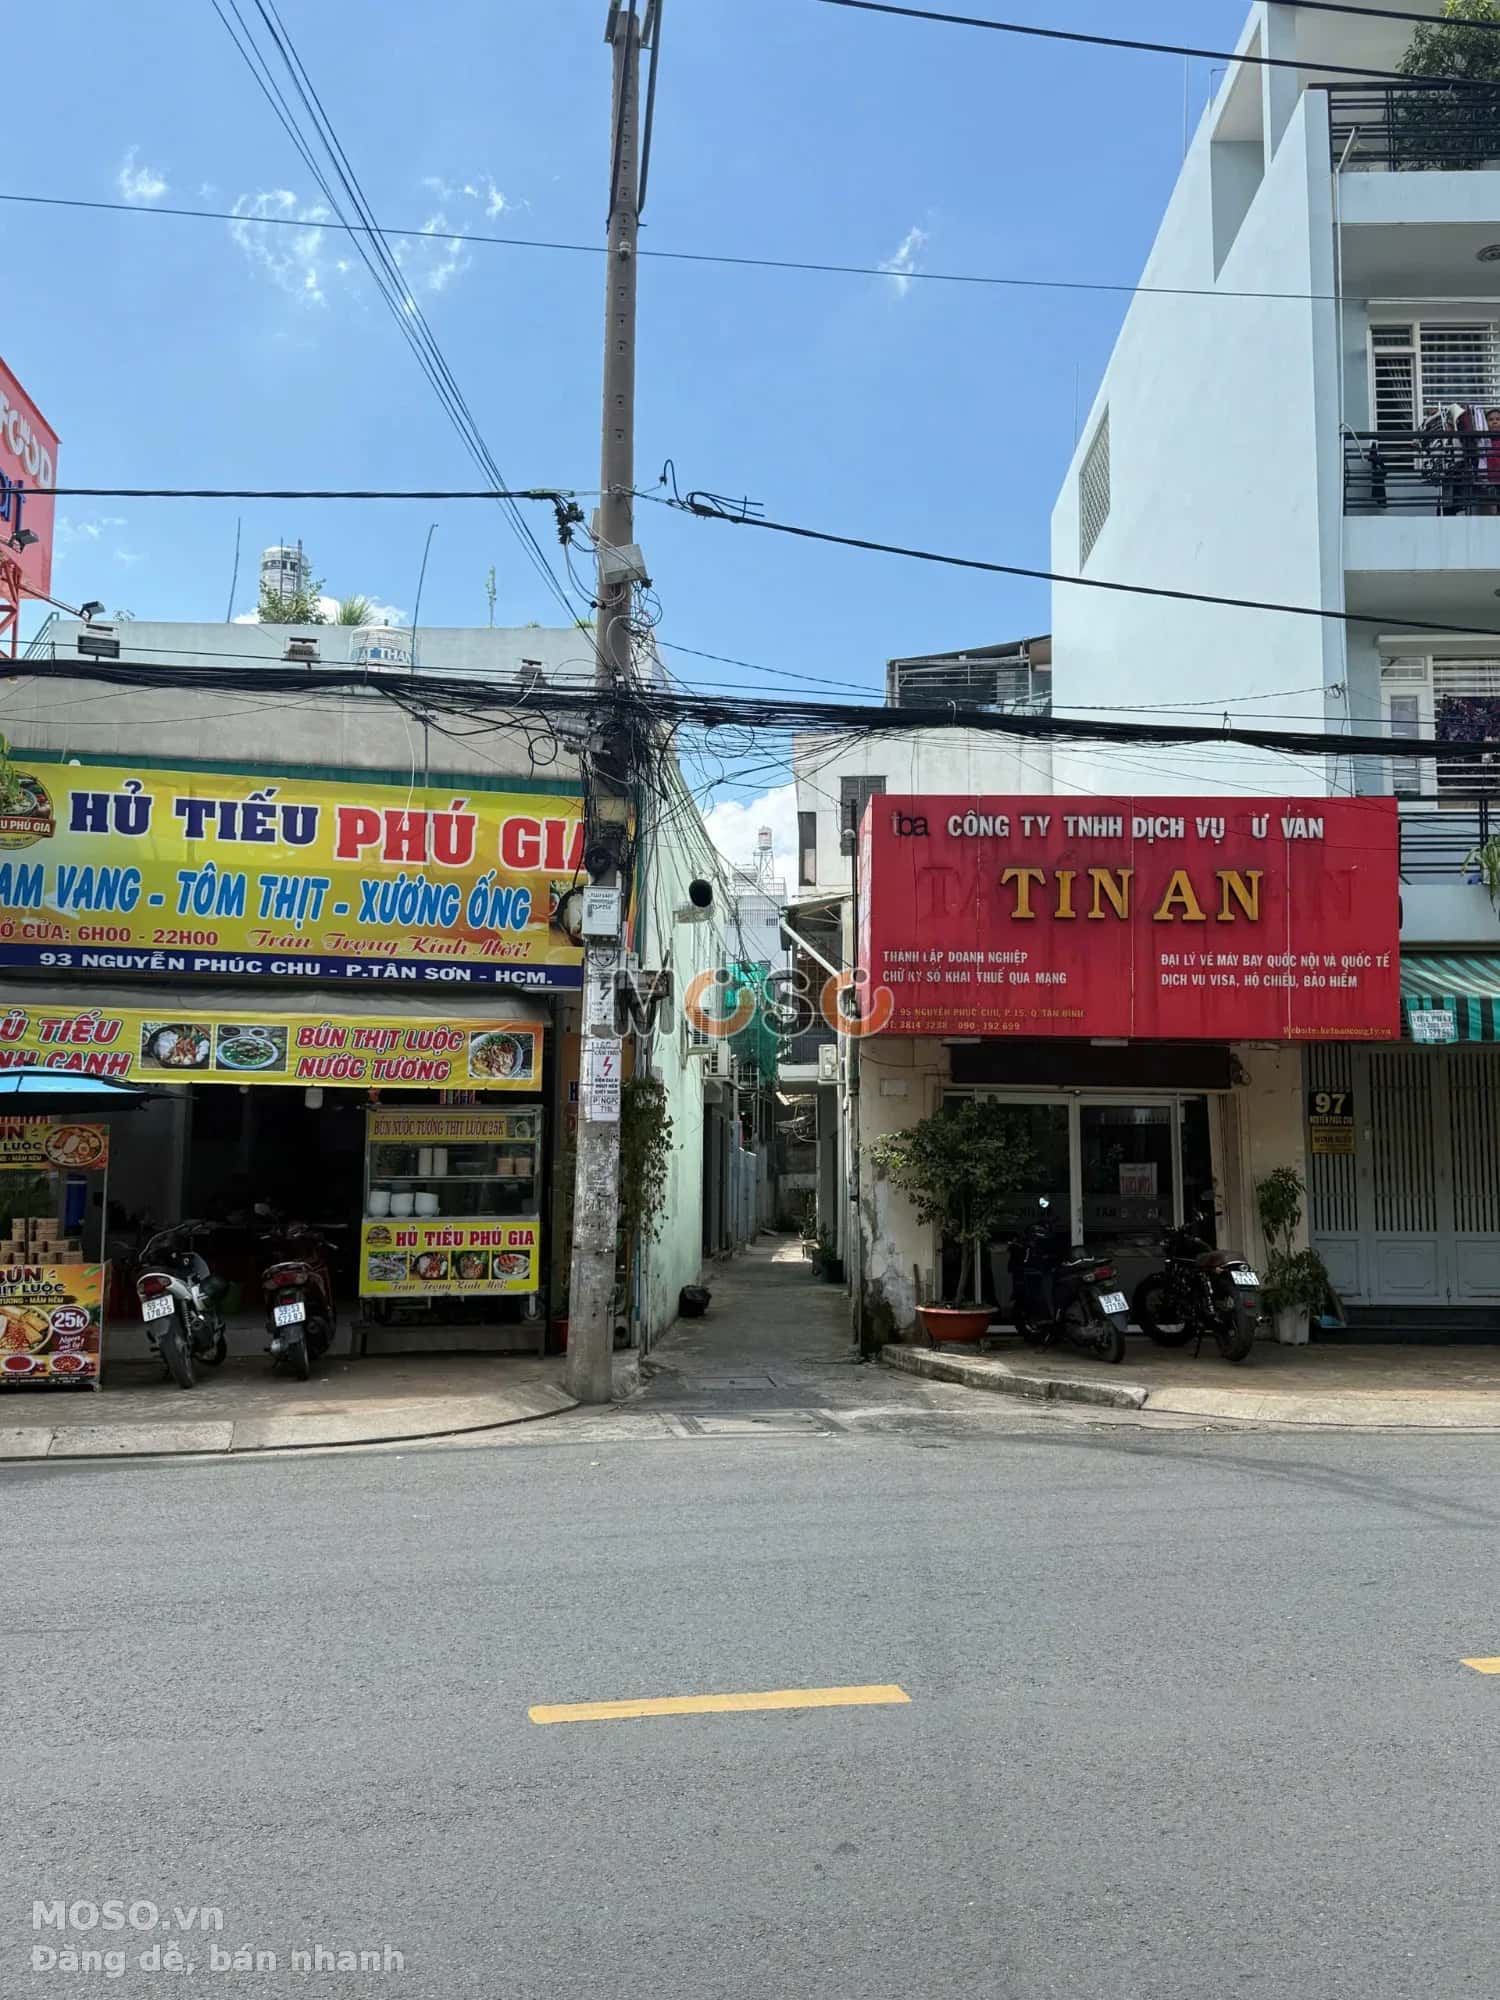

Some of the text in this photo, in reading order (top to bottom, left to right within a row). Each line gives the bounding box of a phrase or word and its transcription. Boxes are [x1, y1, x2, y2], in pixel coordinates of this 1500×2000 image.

[10, 819, 31, 831] PHÚ
[33, 822, 51, 833] GIA
[69, 780, 153, 836] HỦ
[174, 788, 320, 845] TIẾU
[335, 799, 477, 866] PHÚ
[948, 809, 1010, 837] CÔNG
[1020, 815, 1051, 838] TY
[1063, 815, 1123, 838] TNHH
[1132, 816, 1185, 844] DỊCH
[1195, 816, 1225, 844] VỤ
[57, 864, 141, 912] VANG
[149, 894, 164, 906] -
[176, 861, 247, 917] TÔM
[258, 875, 330, 930] THỊT
[333, 902, 350, 915] -
[358, 872, 463, 926] XƯƠNG
[467, 869, 532, 930] ỐNG
[1152, 869, 1264, 921] AN
[22, 918, 71, 940] CỬA:
[78, 926, 132, 943] 6H00
[152, 928, 219, 946] 22H00
[249, 929, 532, 958] Trân Trọng Kính Mời!
[39, 952, 72, 966] 93
[81, 951, 185, 971] NGUYỄN
[194, 957, 262, 974] PHÚC
[270, 961, 321, 976] CHU
[346, 962, 417, 979] P.TÂN
[424, 966, 471, 981] SƠN
[495, 970, 553, 985] HCM.
[948, 951, 984, 964] DOANH
[988, 949, 1028, 966] NGHIỆP
[1161, 953, 1180, 970] ĐẠI
[1243, 954, 1263, 967] BAY
[1267, 951, 1297, 969] QUỐC
[1301, 952, 1320, 970] NỘI
[1341, 951, 1372, 970] QUỐC
[1376, 950, 1391, 967] TẾ
[883, 967, 904, 983] CHỮ
[945, 971, 971, 983] KHAI
[976, 967, 1005, 984] THUẾ
[1009, 972, 1031, 985] QUA
[1035, 972, 1067, 986] MẠNG
[1161, 974, 1187, 989] DỊCH
[1210, 974, 1241, 988] VISA,
[1303, 970, 1326, 988] BẢO
[1329, 970, 1358, 987] HIỂM
[39, 1008, 122, 1044] TIẾU
[297, 1022, 465, 1056] BÚN THỊT LUỘC
[46, 1051, 132, 1077] CANH
[297, 1053, 451, 1081] NƯỚC TƯƠNG
[1315, 1092, 1346, 1114] 97
[395, 1224, 535, 1247] HỦ TIẾU PHÚ GIA
[22, 1281, 65, 1296] LUỘC
